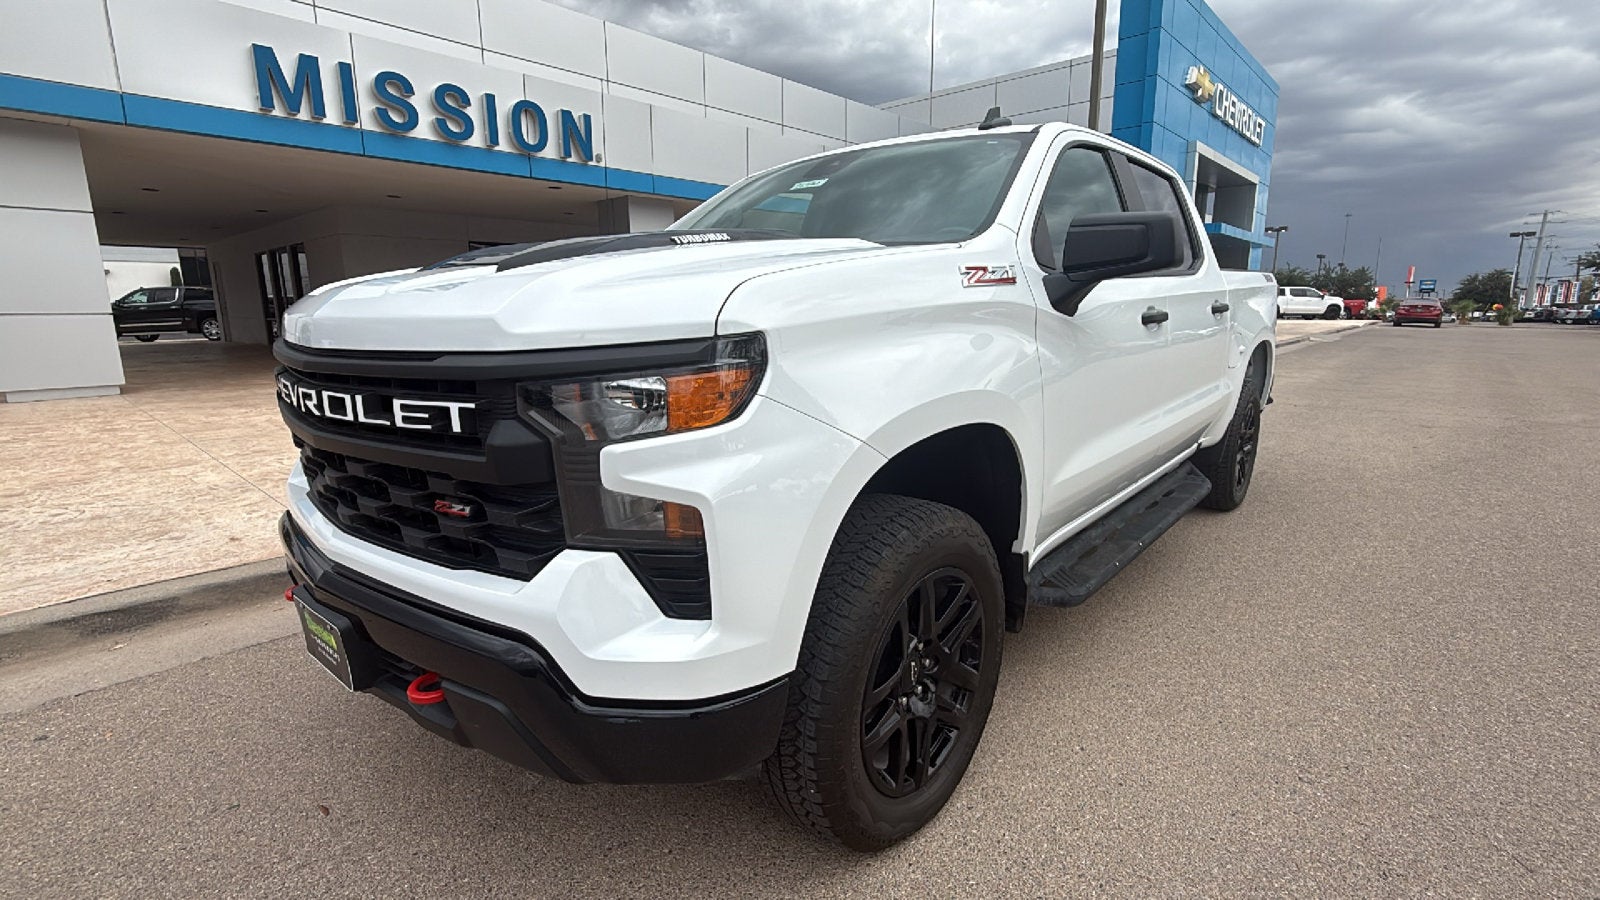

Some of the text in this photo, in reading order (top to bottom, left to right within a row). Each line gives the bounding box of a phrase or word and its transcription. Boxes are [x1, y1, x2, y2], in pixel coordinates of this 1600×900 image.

[251, 43, 595, 163] MISSION
[1214, 83, 1266, 147] CHEVROLET
[671, 232, 731, 245] TURBOMAX
